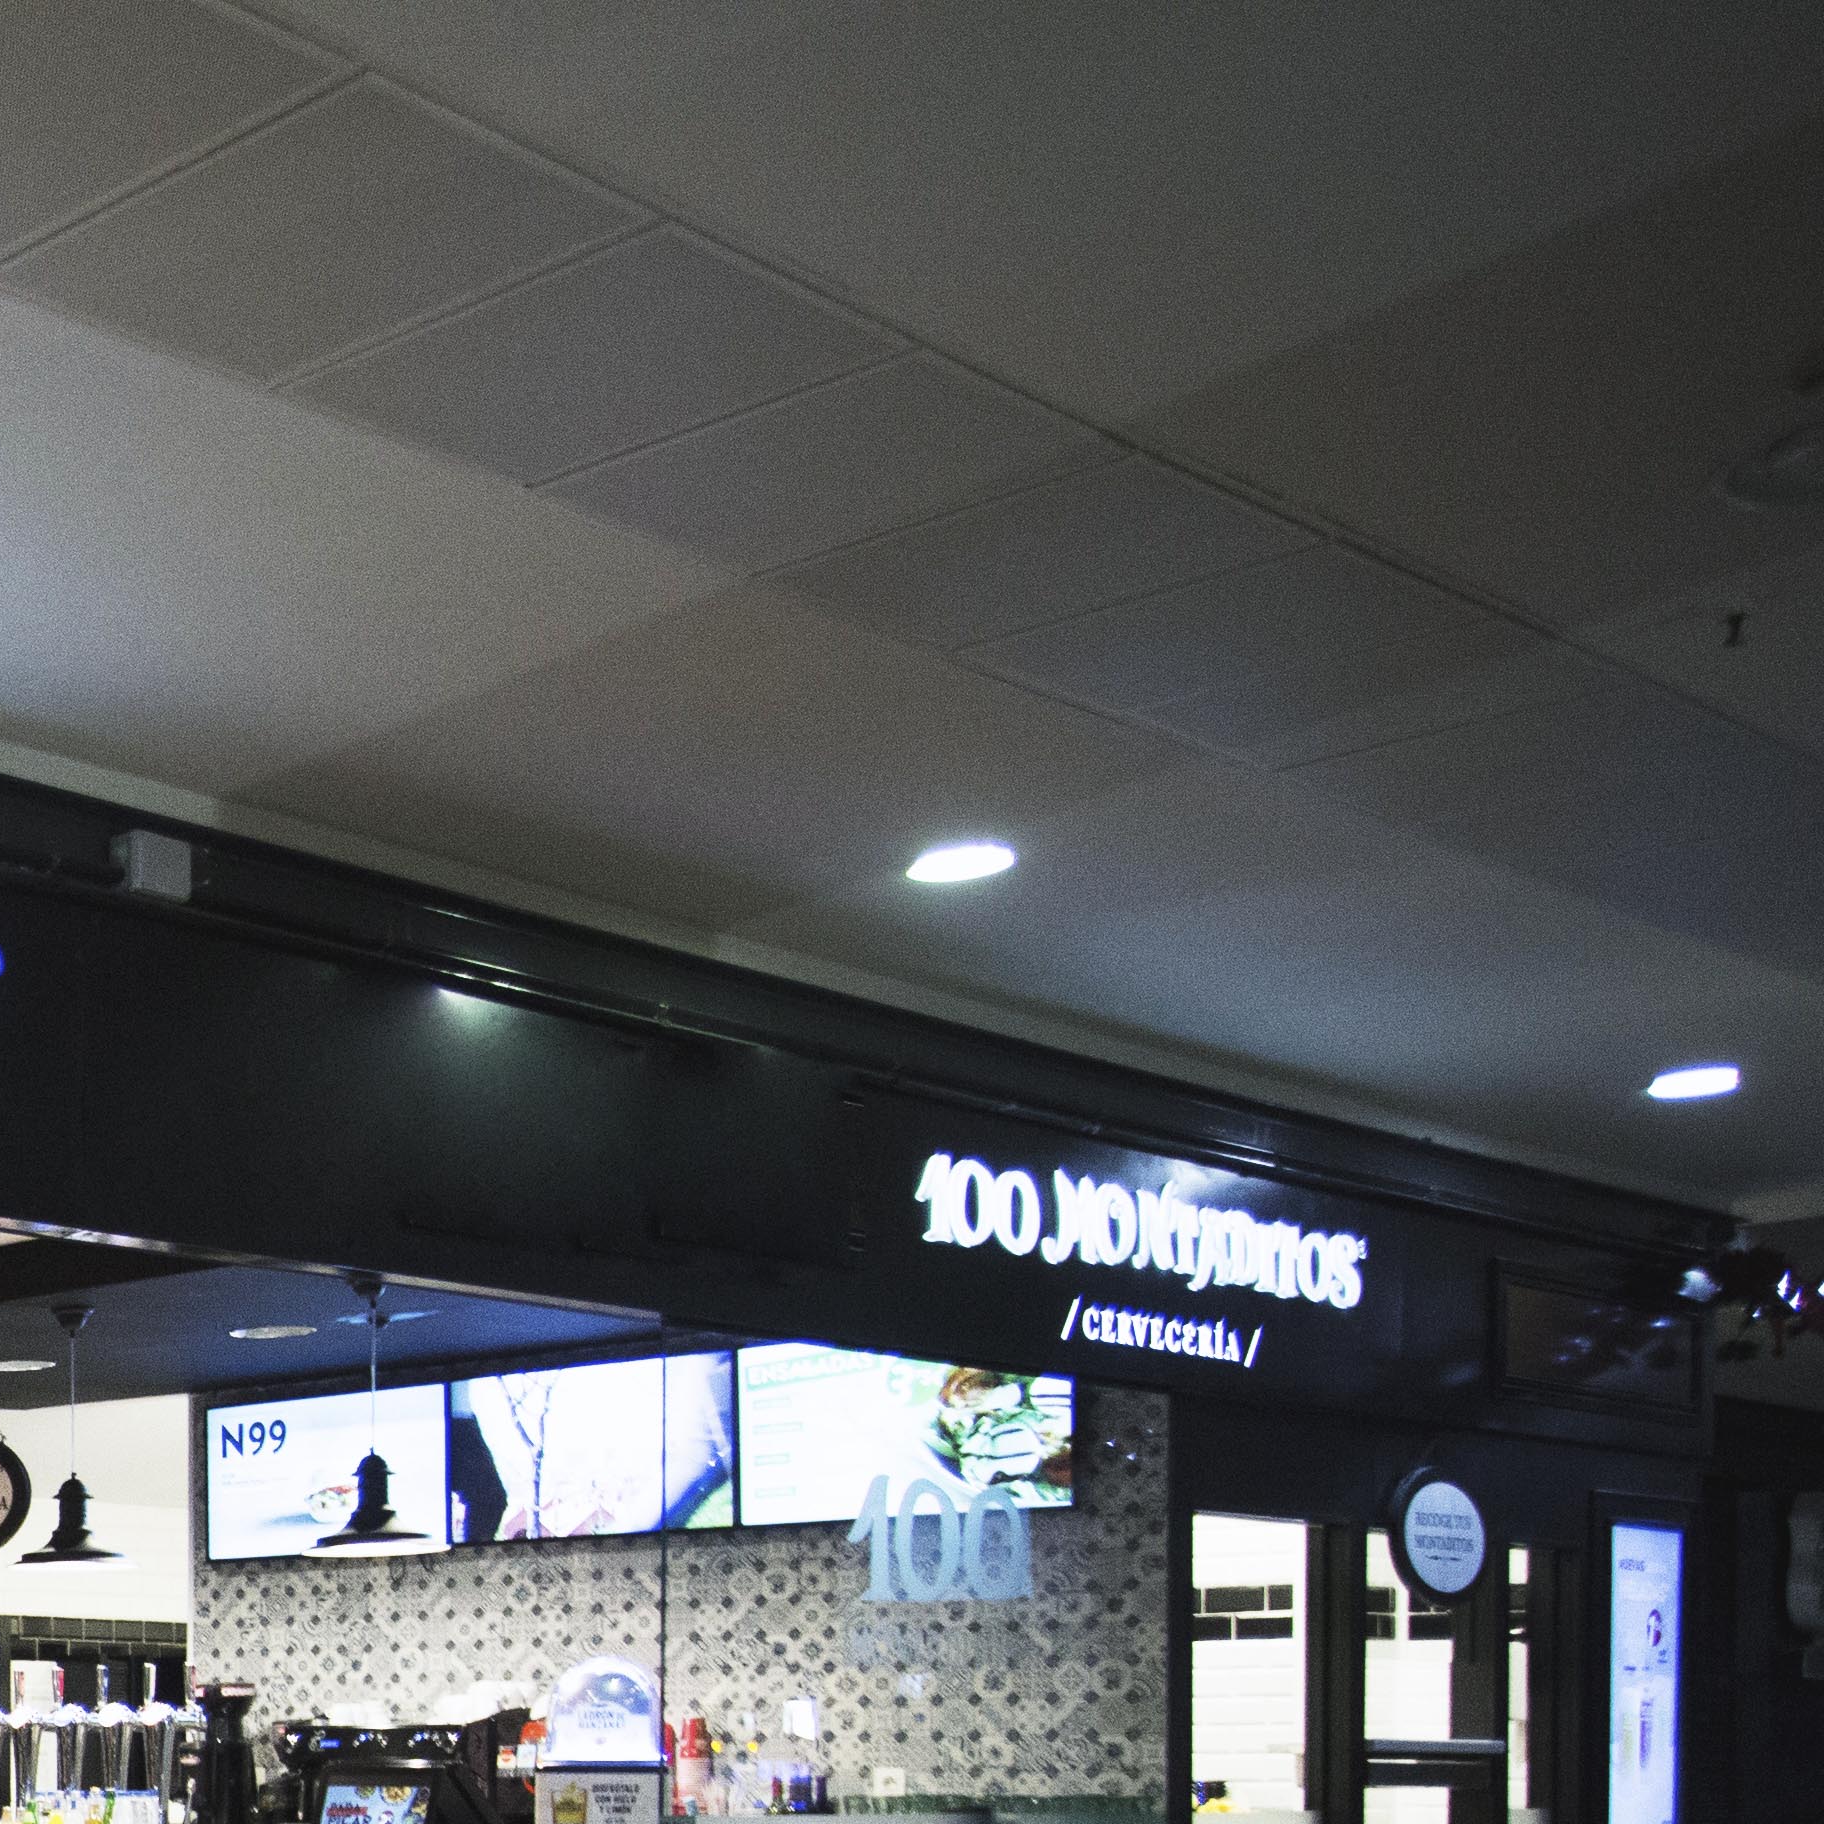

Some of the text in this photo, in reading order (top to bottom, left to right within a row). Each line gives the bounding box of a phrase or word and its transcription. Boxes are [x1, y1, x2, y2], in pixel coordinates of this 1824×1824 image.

[915, 1152, 1042, 1256] 100
[1082, 1302, 1242, 1362] CERVECERÍA
[221, 1419, 287, 1459] N99
[847, 1474, 1031, 1602] 100
[1415, 1511, 1453, 1528] RECOGE
